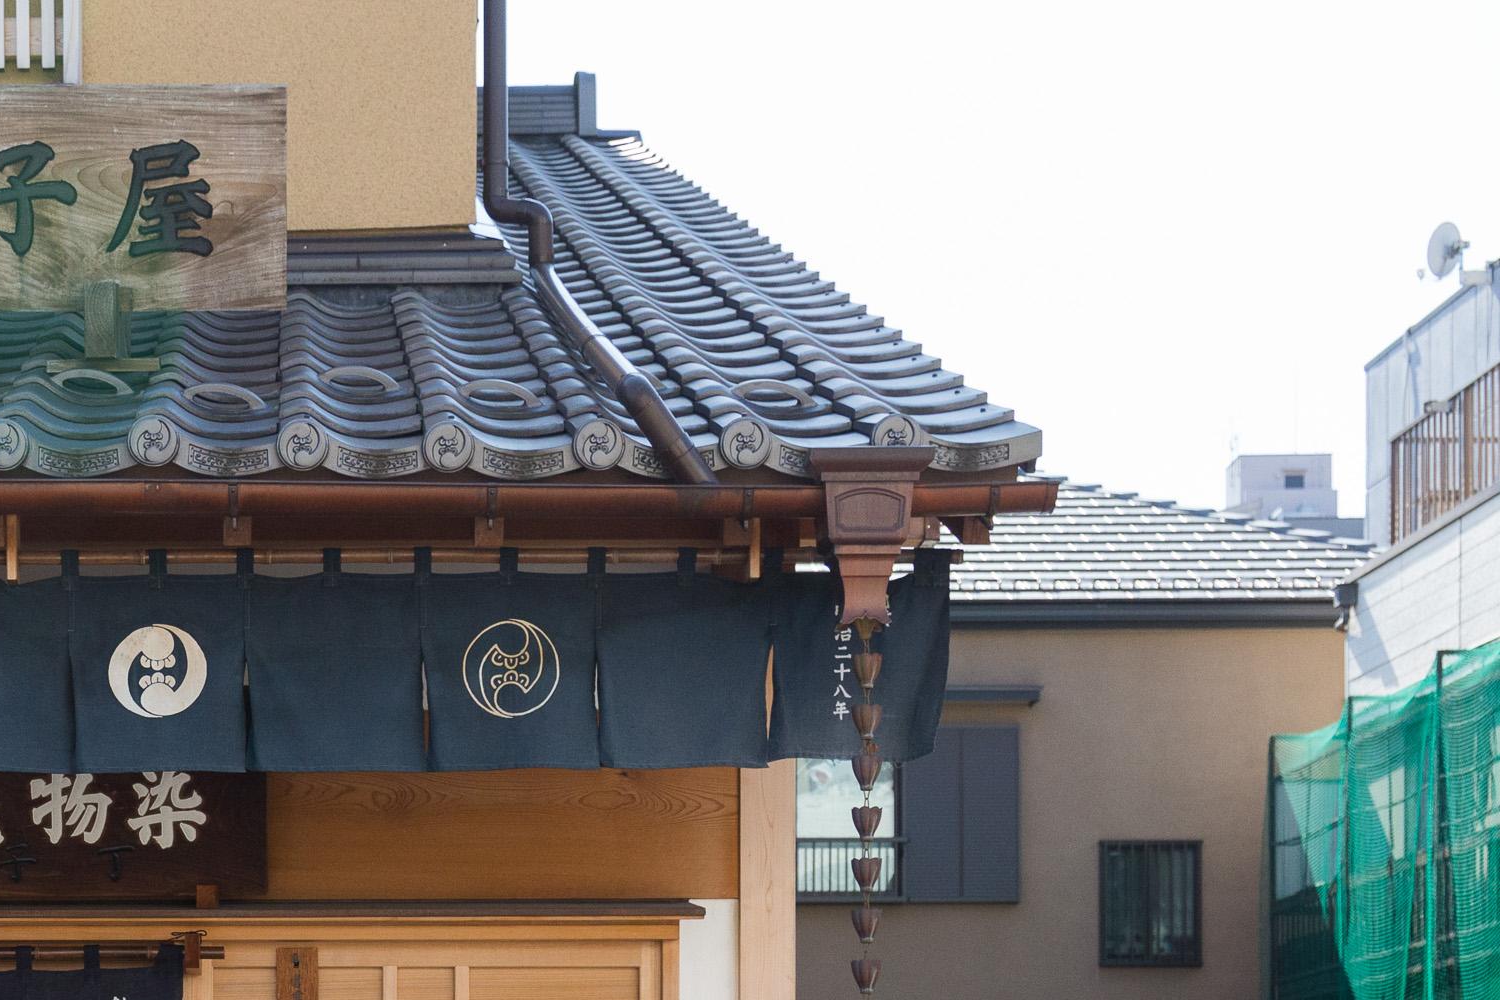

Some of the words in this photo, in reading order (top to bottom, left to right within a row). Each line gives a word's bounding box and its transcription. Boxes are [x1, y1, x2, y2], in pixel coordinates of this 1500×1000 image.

[833, 605, 852, 721] 治二十八年
